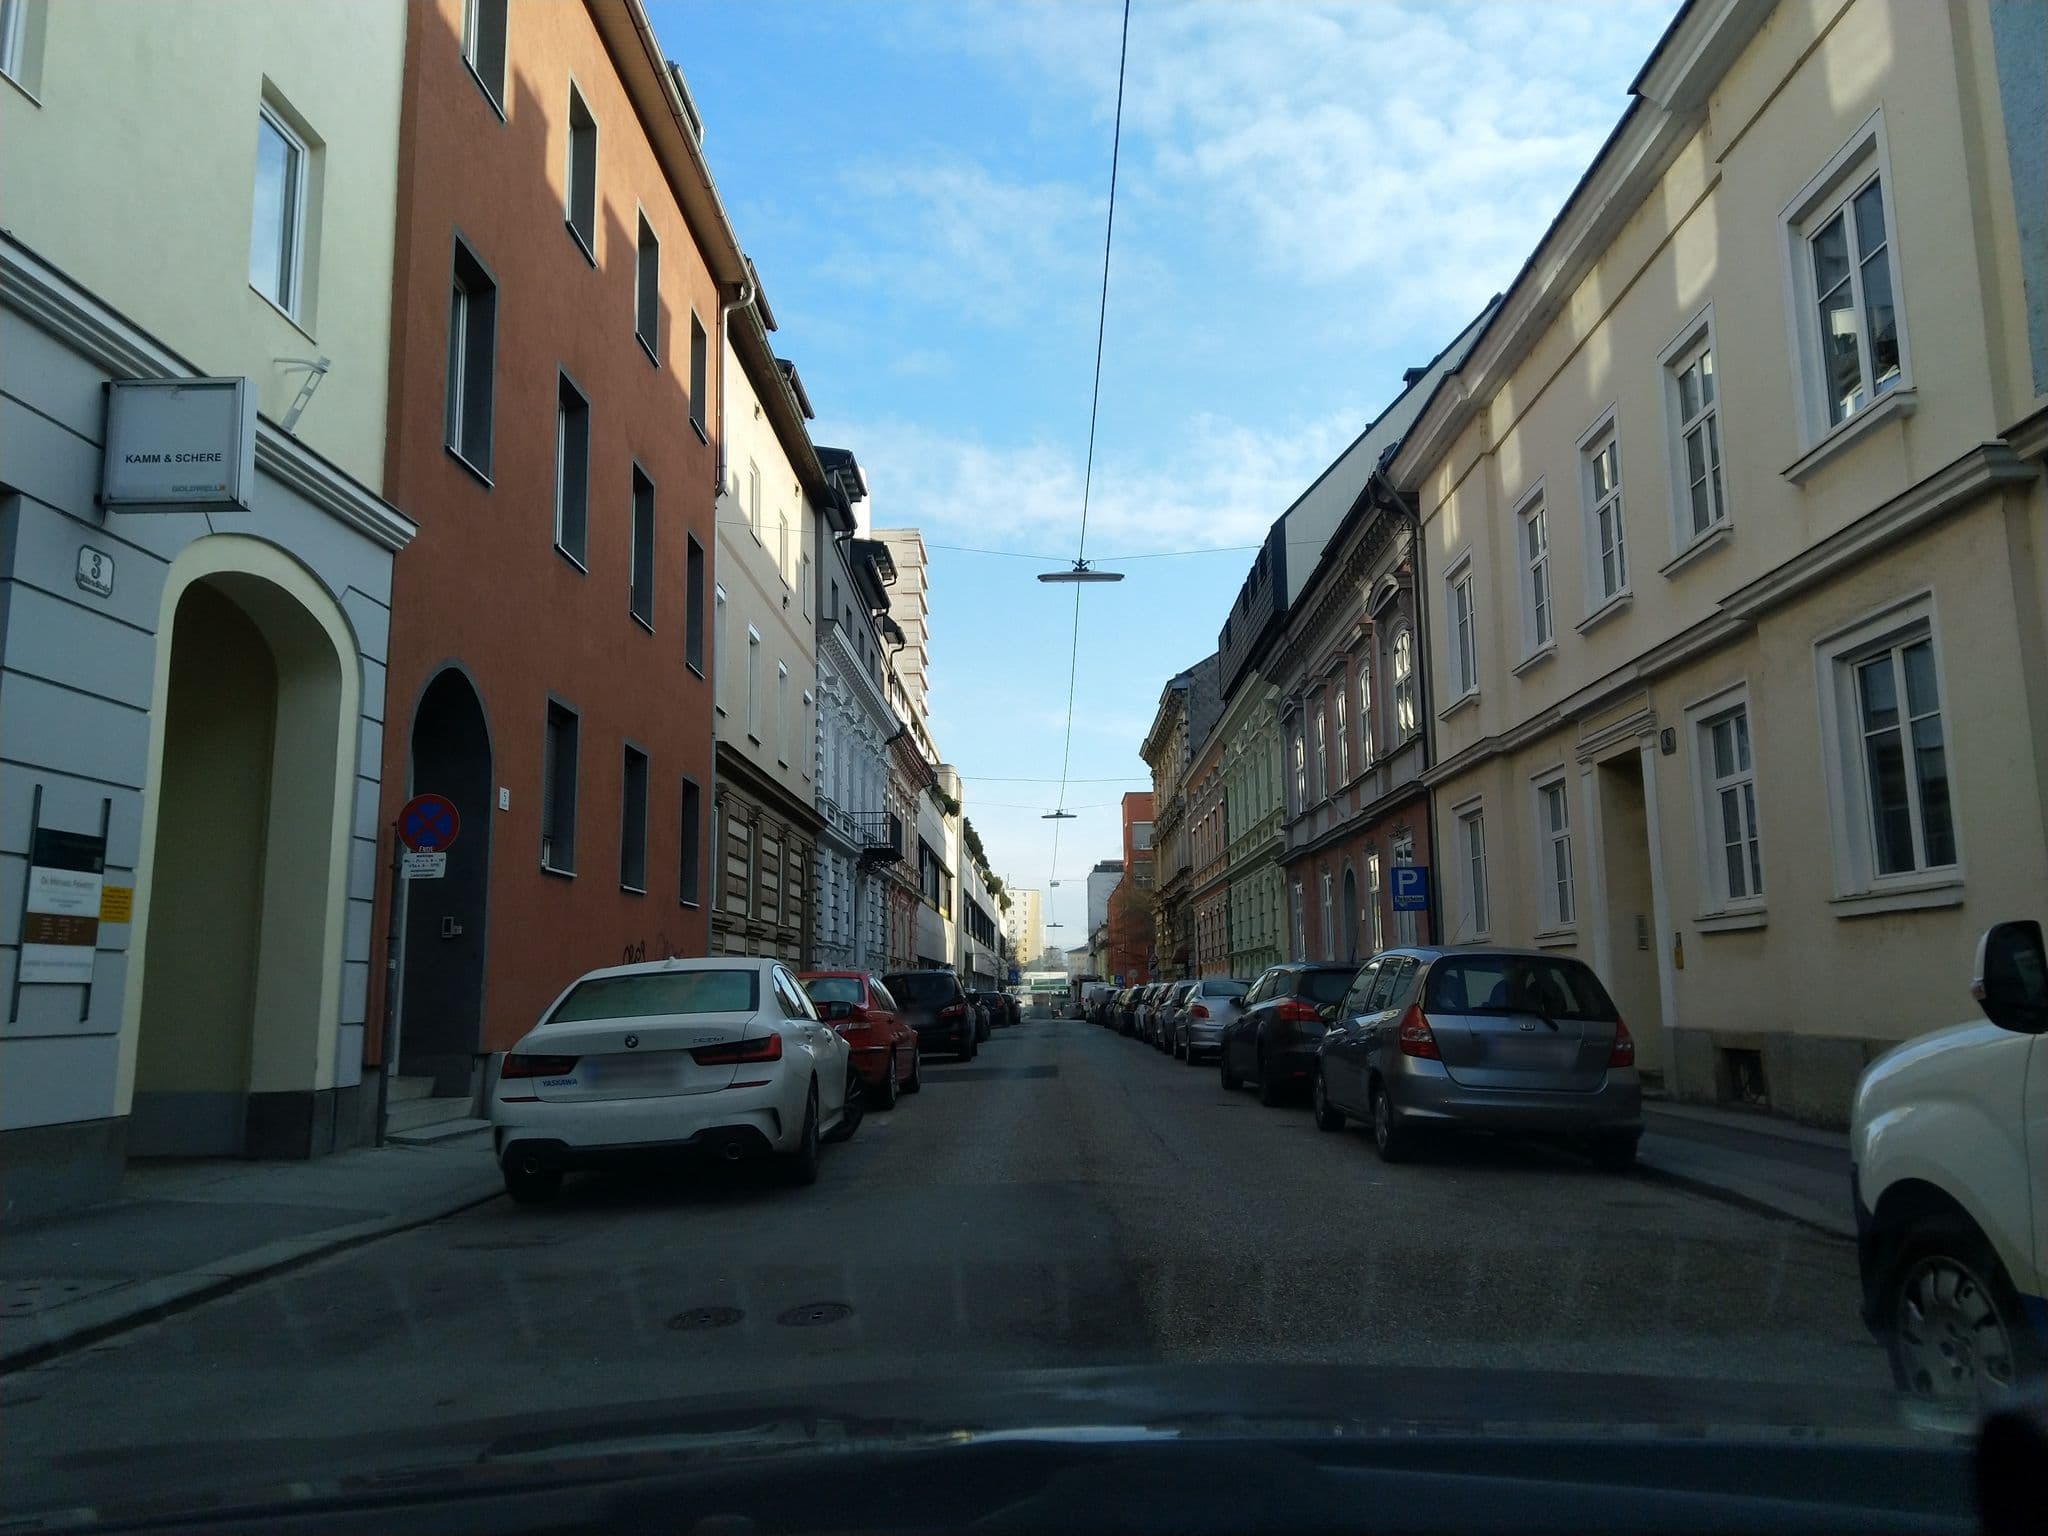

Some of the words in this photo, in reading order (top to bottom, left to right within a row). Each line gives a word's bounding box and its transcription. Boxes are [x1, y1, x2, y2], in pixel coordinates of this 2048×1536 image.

[125, 454, 161, 463] KAMM
[164, 454, 172, 463] &
[175, 453, 222, 463] SCHERE
[91, 554, 102, 579] 3
[1398, 870, 1418, 896] P
[542, 1079, 578, 1087] YASKAWA
